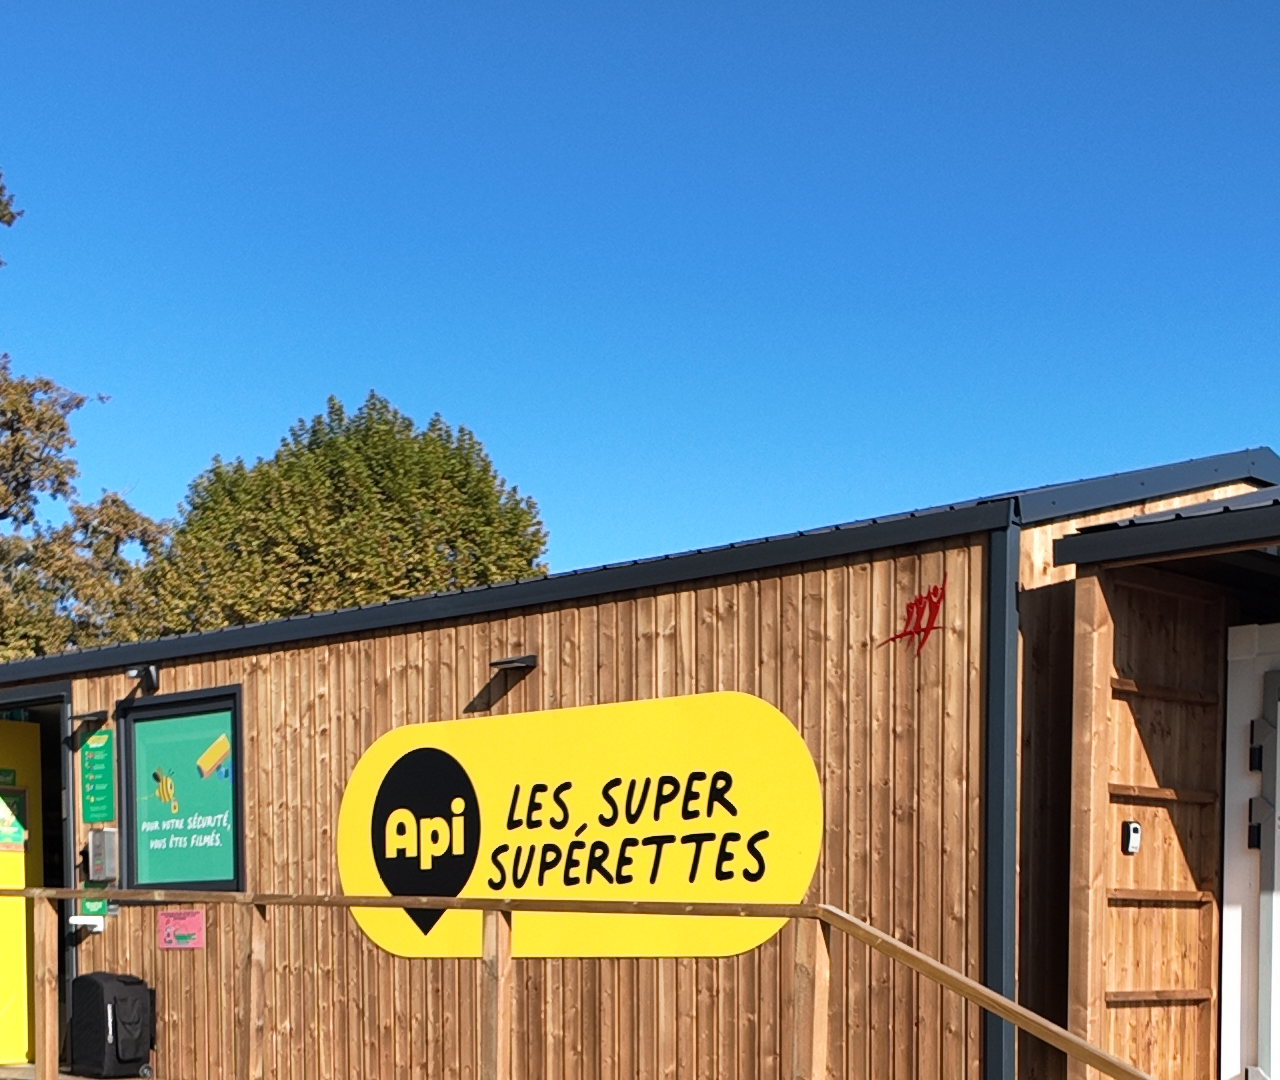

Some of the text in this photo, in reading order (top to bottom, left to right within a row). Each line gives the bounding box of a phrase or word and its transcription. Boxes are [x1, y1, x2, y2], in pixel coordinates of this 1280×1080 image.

[142, 810, 231, 832] POUR VOTRE SÉCURITÉ,
[506, 771, 738, 830] LES SUPER
[150, 838, 166, 849] VOUS
[190, 830, 222, 848] FILMÉS.
[385, 797, 466, 870] Api
[487, 823, 770, 891] SUPÉRETTES
